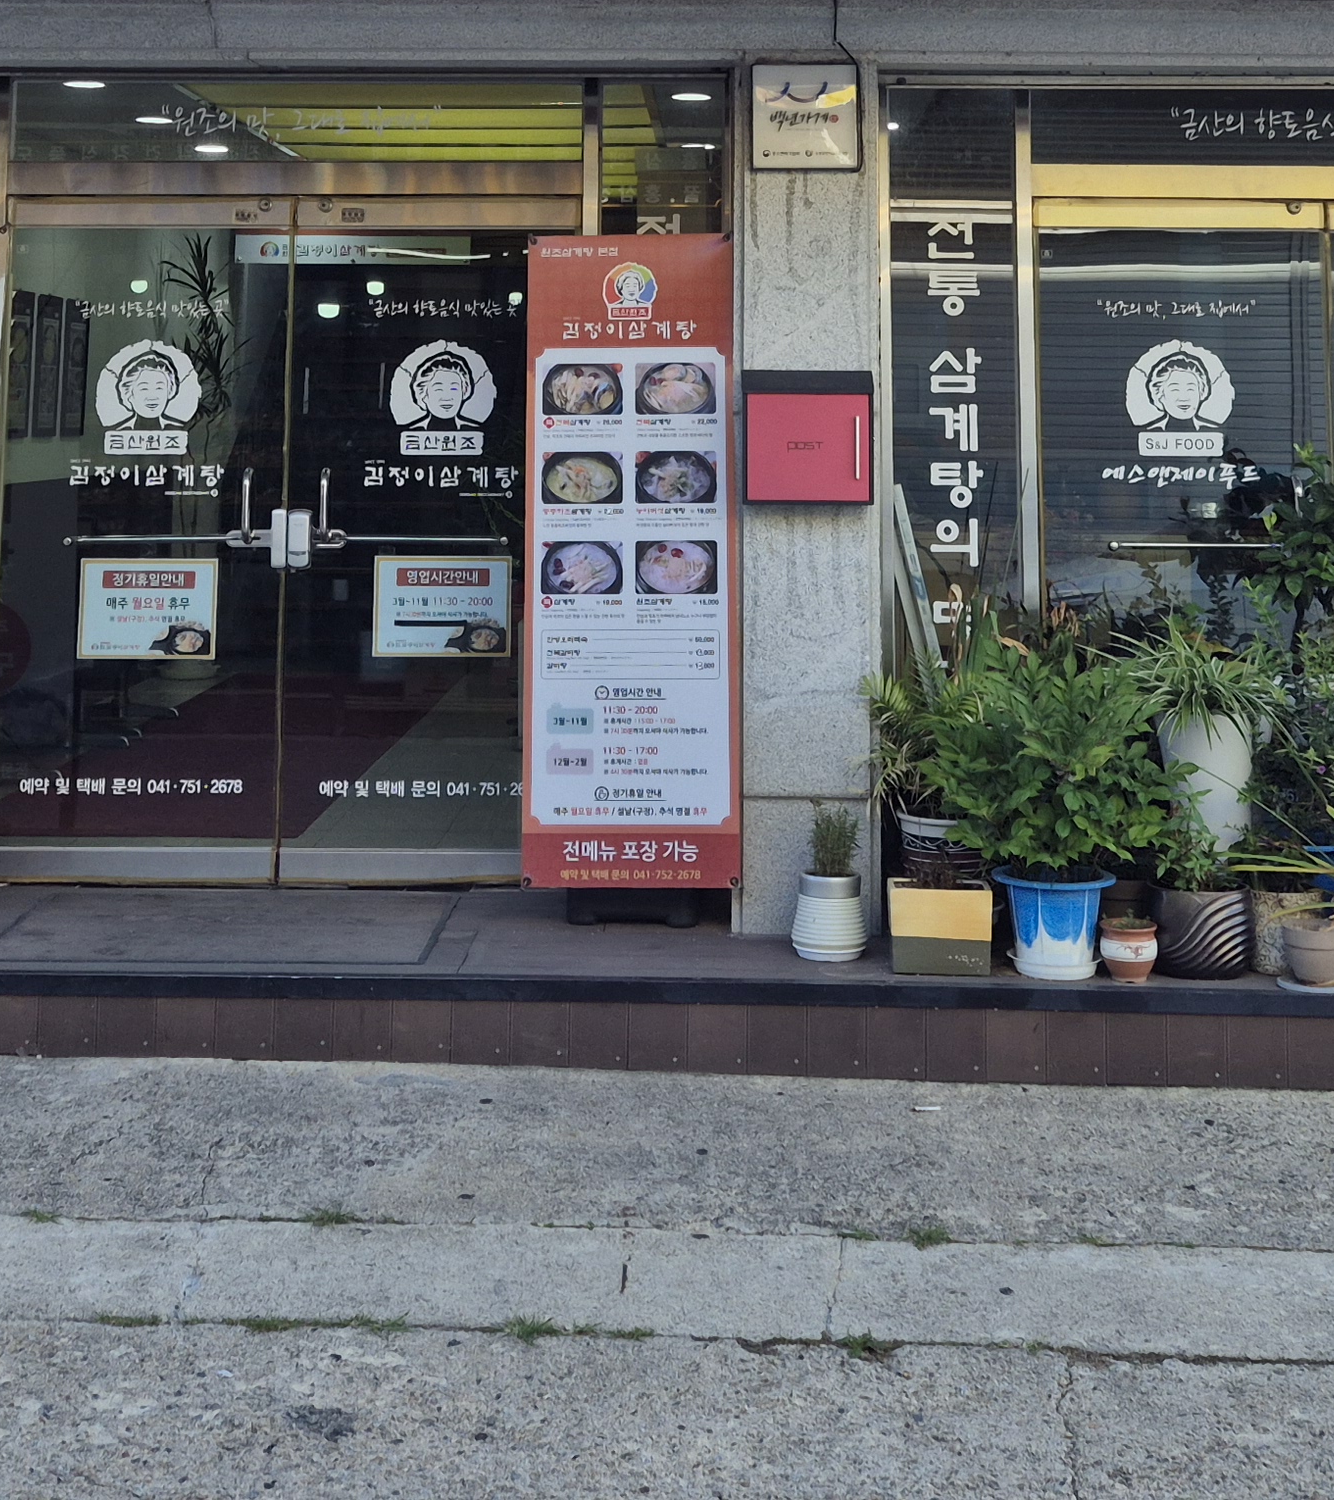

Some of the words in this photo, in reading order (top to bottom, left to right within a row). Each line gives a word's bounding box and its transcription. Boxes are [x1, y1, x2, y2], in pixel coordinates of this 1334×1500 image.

[769, 110, 830, 133] 백년가게
[562, 319, 698, 341] 김정이삼계탕
[109, 434, 181, 451] 금산원조
[405, 435, 477, 452] 금산원조
[1145, 437, 1169, 451] S&J
[1175, 438, 1215, 450] FOOD
[929, 347, 985, 568] 삼계탕의
[69, 463, 226, 487] 김정이삼계탕
[363, 465, 520, 489] 김정이삼계탕
[1101, 461, 1262, 490] 에스앤제이푸드
[112, 572, 185, 587] 정기휴일안내
[406, 569, 479, 584] 영업시간안내
[106, 597, 128, 610] 매주
[168, 597, 190, 610] 휴무
[646, 688, 662, 698] 안내
[602, 706, 626, 715] 11:30
[634, 706, 658, 715] 20:00
[602, 747, 626, 755] 11:30
[635, 747, 658, 755] 17:00
[19, 777, 50, 795] 예약
[55, 777, 70, 795] 및
[76, 777, 106, 796] 택배
[111, 777, 142, 796] 문의
[319, 779, 349, 797] 예약
[354, 779, 369, 797] 및
[375, 779, 405, 798] 택배
[410, 779, 441, 798] 문의
[646, 788, 662, 798] 안내
[563, 840, 617, 863] 전메뉴
[621, 840, 658, 863] 포장
[662, 840, 699, 863] 가능
[560, 869, 578, 881] 예약
